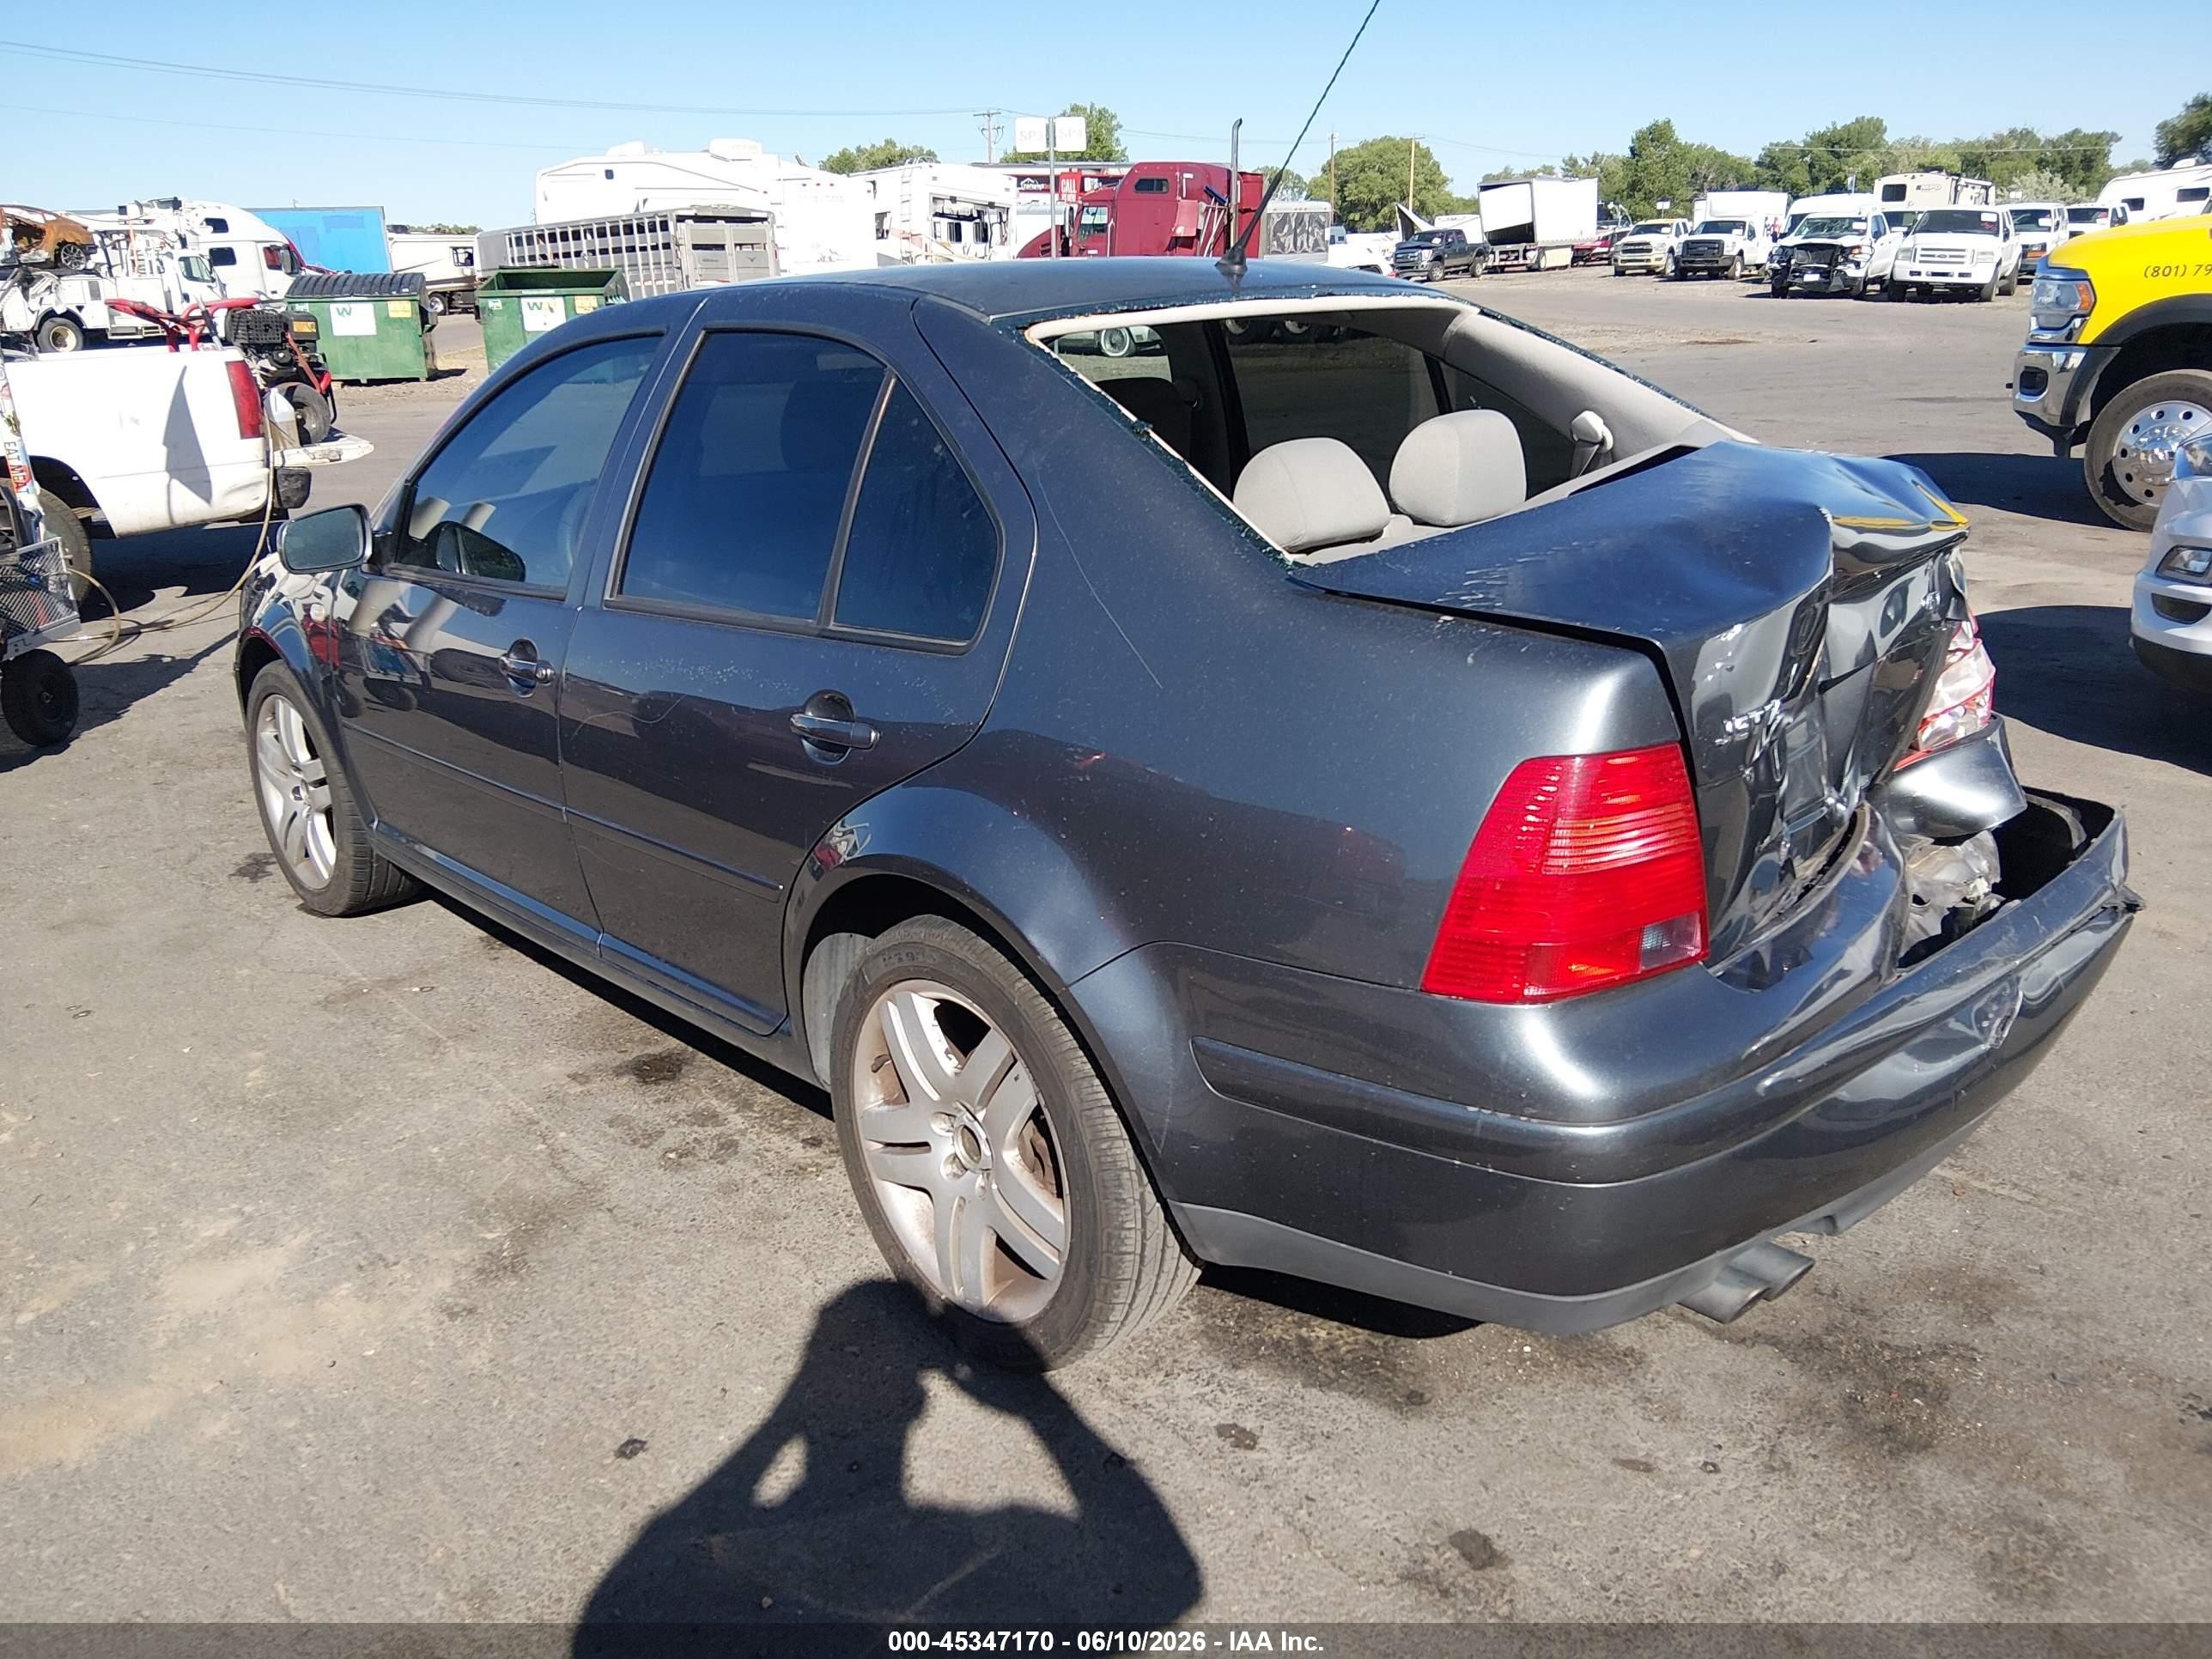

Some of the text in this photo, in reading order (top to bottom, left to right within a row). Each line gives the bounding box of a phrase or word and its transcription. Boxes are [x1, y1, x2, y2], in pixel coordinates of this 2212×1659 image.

[1060, 178, 1077, 193] CALL
[2143, 264, 2187, 278] (801)
[4, 441, 29, 494] EAT MEAT
